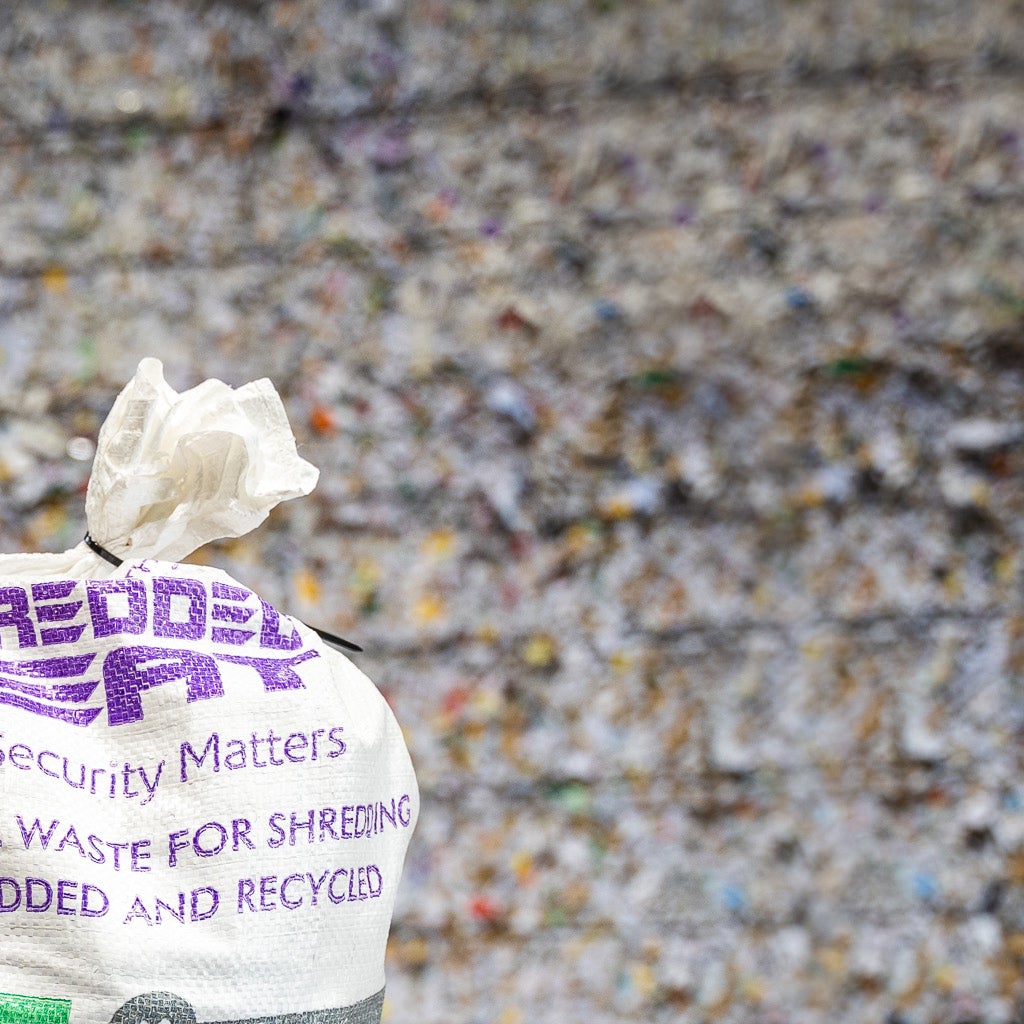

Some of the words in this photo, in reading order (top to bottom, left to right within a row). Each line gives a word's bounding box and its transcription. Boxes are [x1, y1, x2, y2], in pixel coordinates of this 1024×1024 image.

[180, 726, 346, 782] Matters
[16, 815, 152, 872] WASTE
[169, 817, 256, 868] FOR
[268, 794, 411, 849] SHREDDING
[123, 887, 220, 926] AND
[238, 864, 383, 914] RECYCLED
